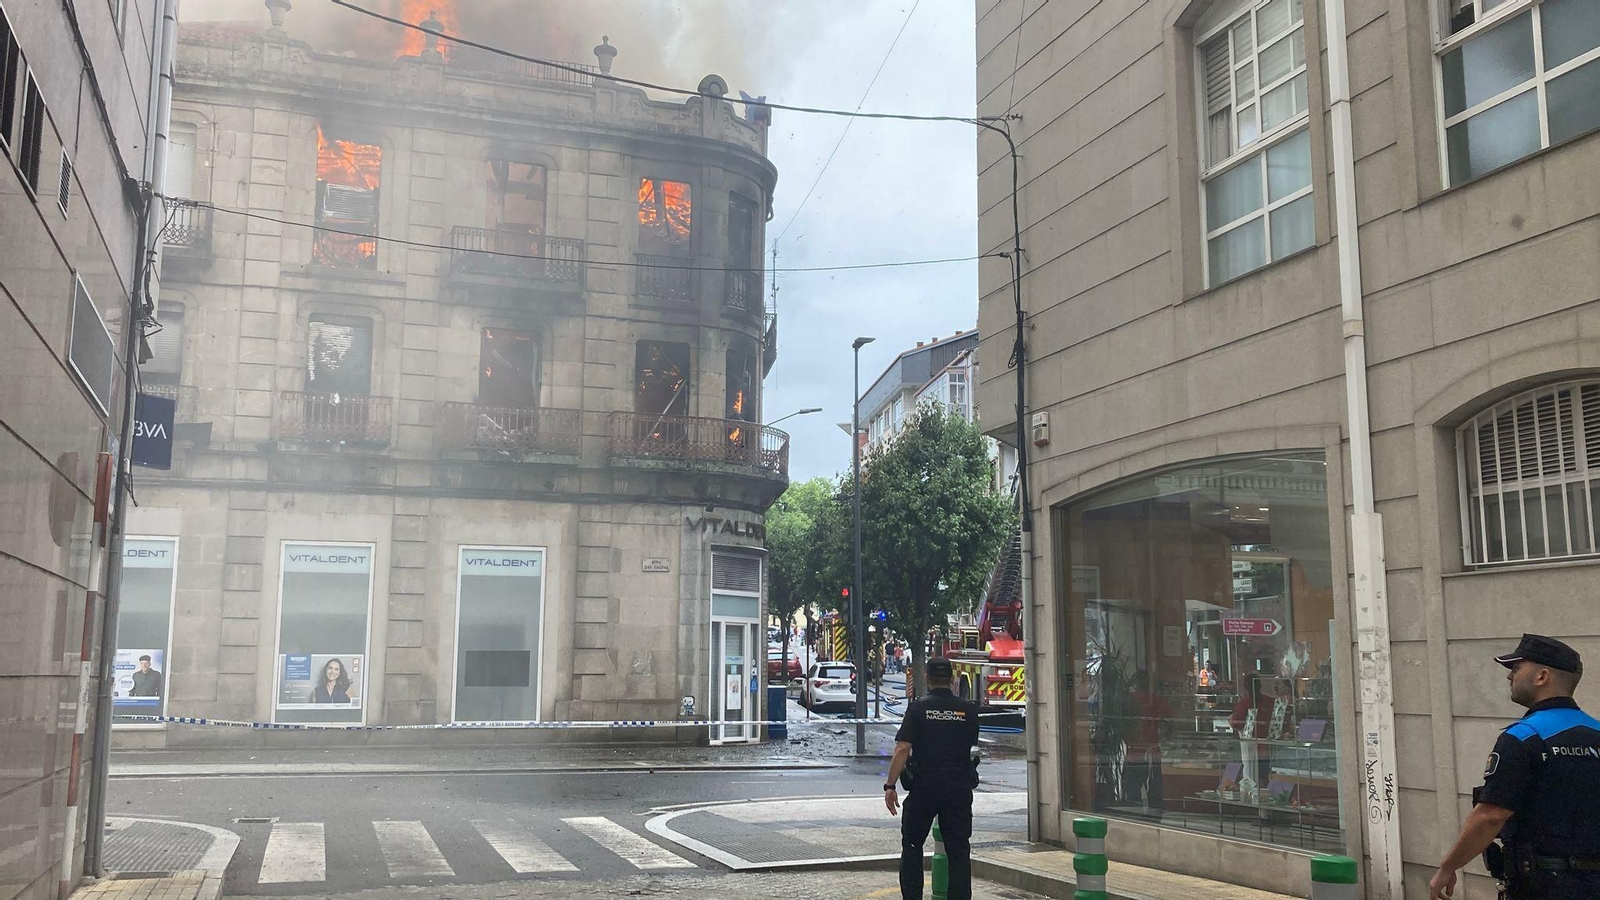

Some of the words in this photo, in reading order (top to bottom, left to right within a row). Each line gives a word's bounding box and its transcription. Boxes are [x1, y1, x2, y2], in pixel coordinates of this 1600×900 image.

[289, 554, 366, 564] VITALDENT
[466, 557, 537, 567] VITALDENT
[1552, 745, 1591, 756] POLICÍA
